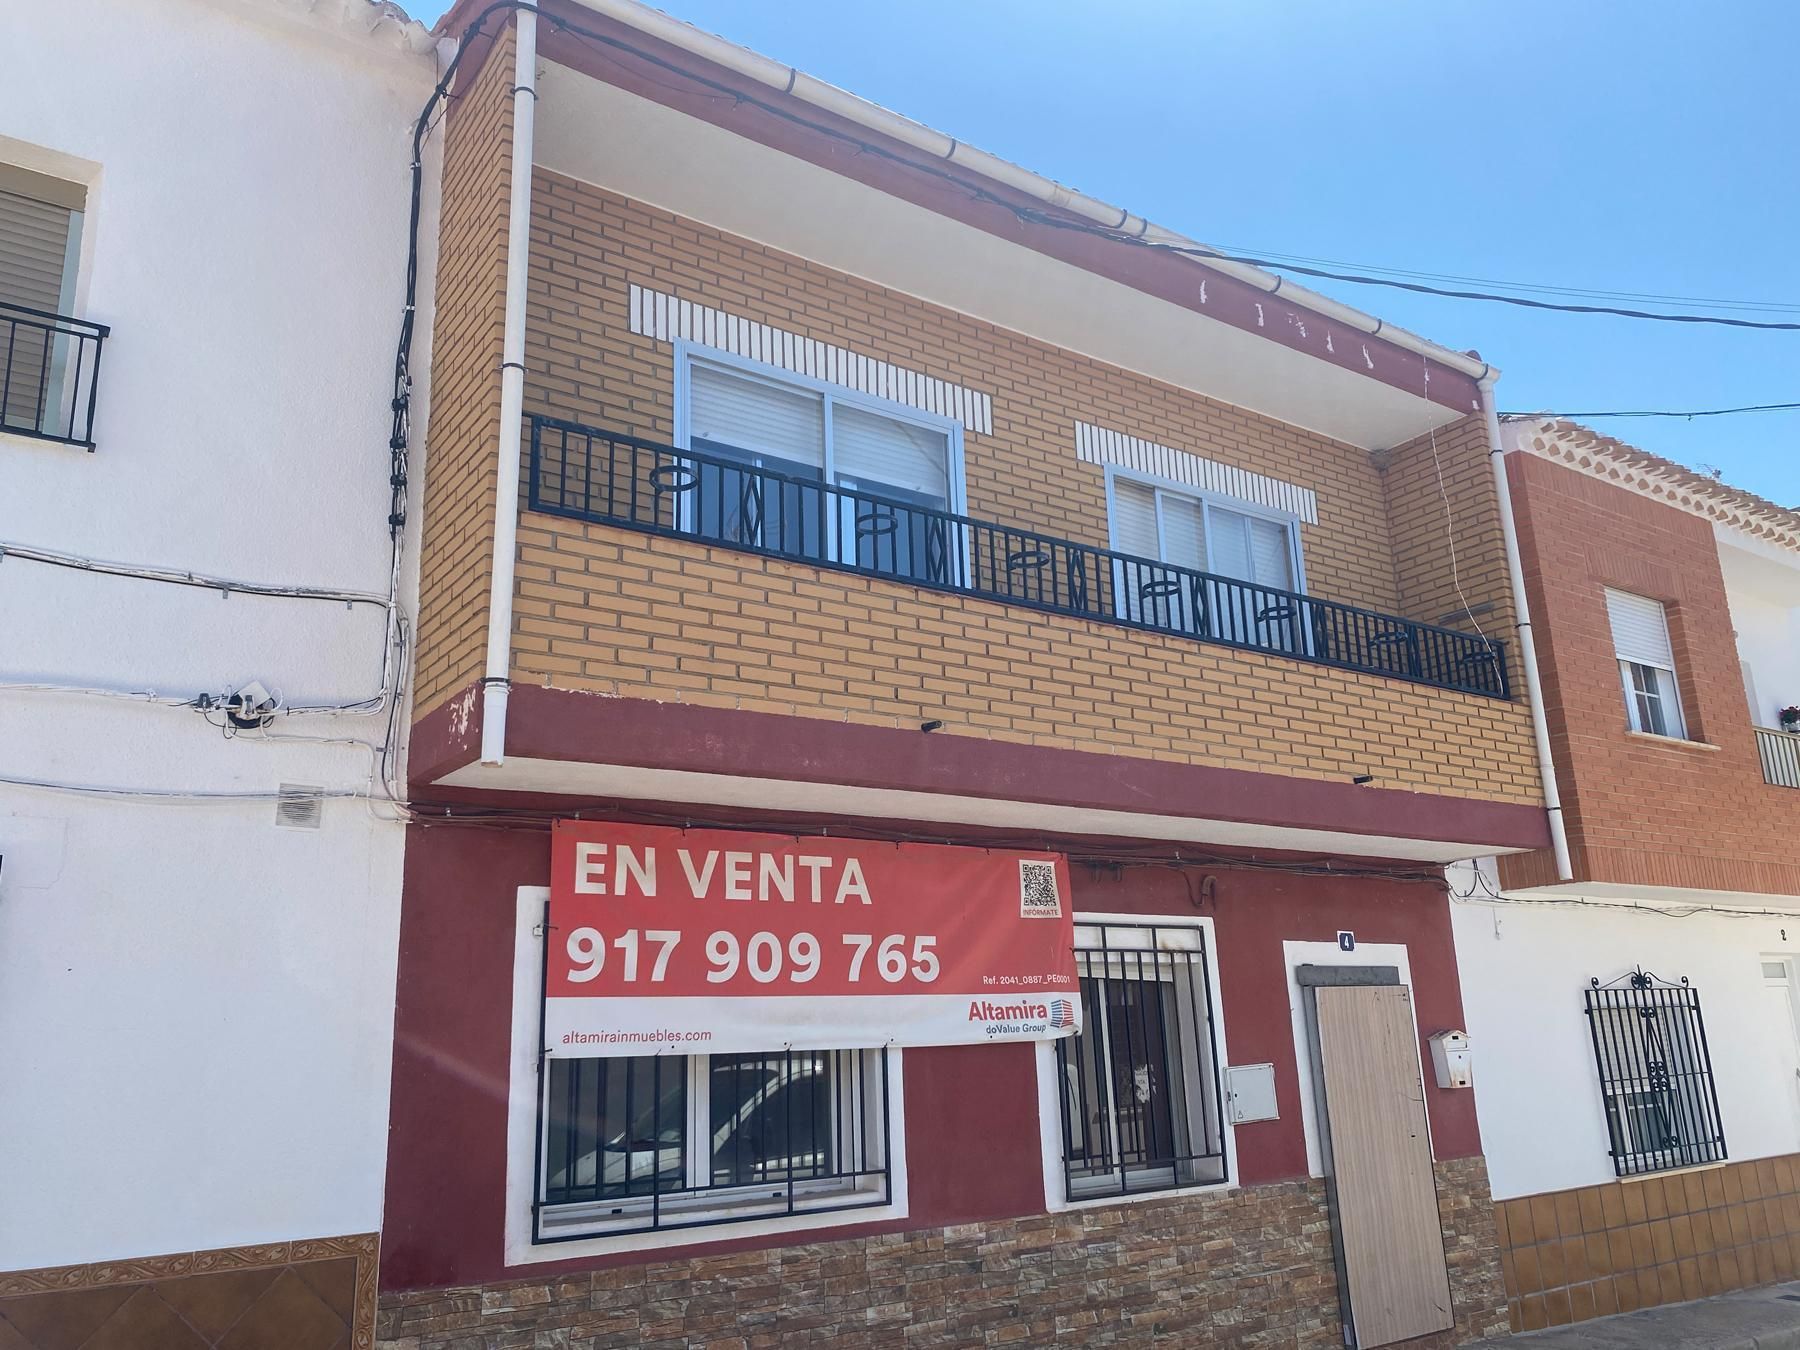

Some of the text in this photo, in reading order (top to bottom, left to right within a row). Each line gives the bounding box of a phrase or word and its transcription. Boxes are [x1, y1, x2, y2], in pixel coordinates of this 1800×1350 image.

[575, 841, 872, 905] EN VENTA
[1344, 935, 1350, 949] 4
[566, 927, 940, 983] 917 909 765
[983, 974, 1071, 985] Ref. 2041_0887_PE0001
[968, 1000, 1048, 1021] Altamira
[986, 1023, 1047, 1034] doValue Group
[562, 1029, 712, 1044] altamirainmuebles.com
